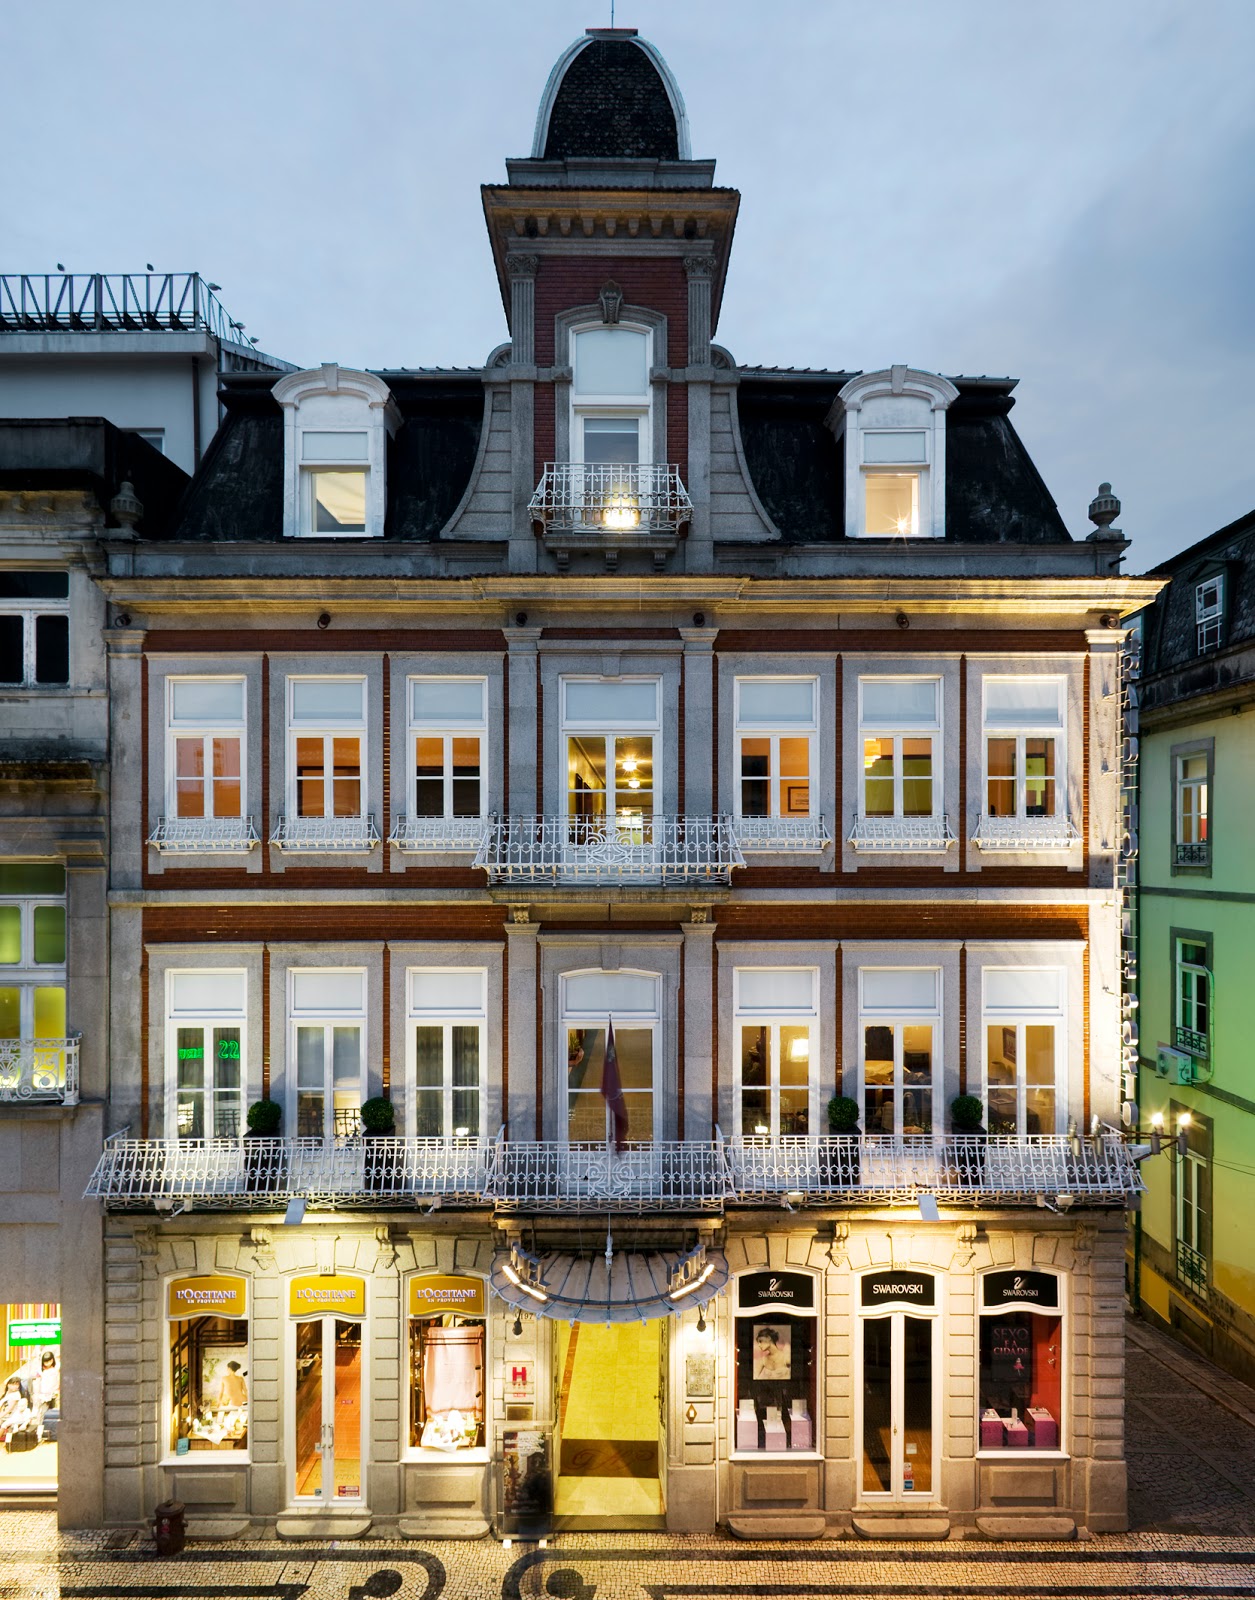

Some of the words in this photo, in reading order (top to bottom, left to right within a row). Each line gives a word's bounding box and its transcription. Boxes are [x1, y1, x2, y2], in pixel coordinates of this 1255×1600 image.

[1122, 992, 1139, 1128] PORTO
[894, 1261, 908, 1269] 203
[176, 1288, 237, 1299] L'OCCITANE
[296, 1287, 357, 1299] L'OCCITANE
[417, 1287, 477, 1299] L'OCCITANE
[757, 1290, 794, 1298] SWAROVSKI
[872, 1284, 923, 1294] SWAROVSKI
[1002, 1289, 1039, 1297] SWAROVSKI
[520, 1312, 534, 1320] 197
[512, 1366, 527, 1382] H
